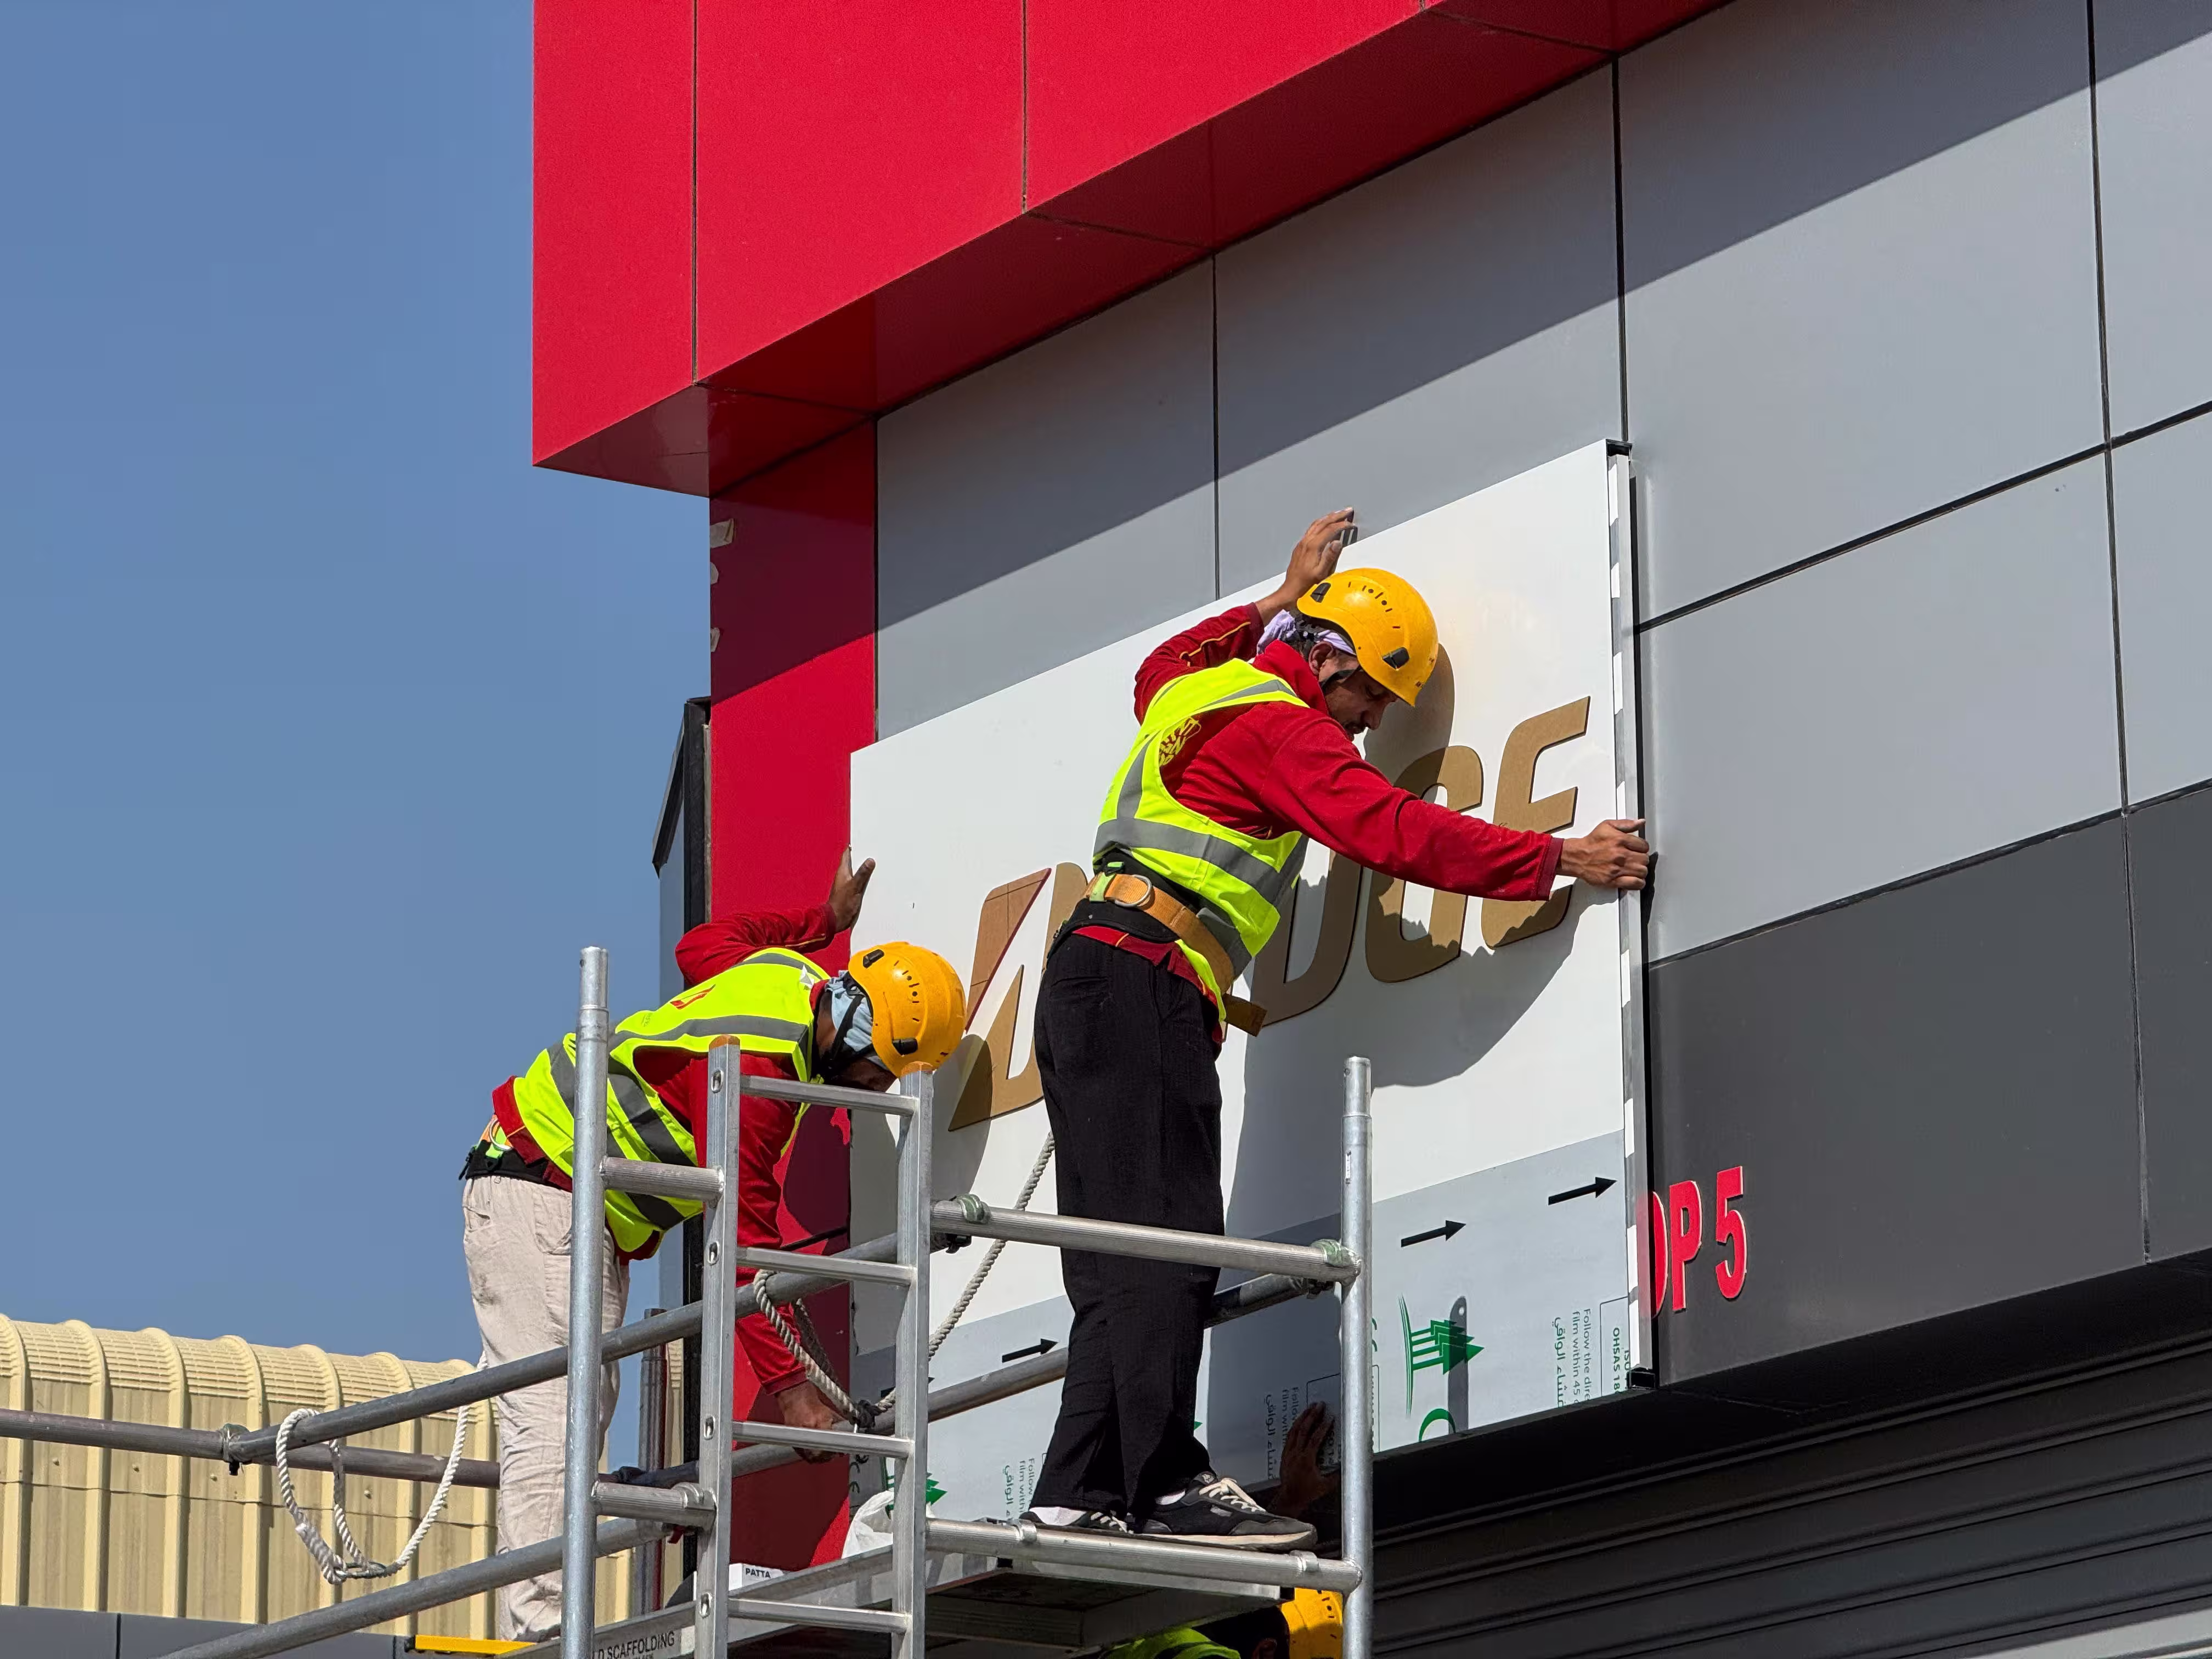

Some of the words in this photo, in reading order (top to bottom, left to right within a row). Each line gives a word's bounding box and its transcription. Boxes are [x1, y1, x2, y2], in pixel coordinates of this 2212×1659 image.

[1716, 1166, 1747, 1300] 5
[1551, 1317, 1566, 1360] الواقي
[1572, 1380, 1580, 1395] 45
[746, 1568, 771, 1578] PATTA
[607, 1631, 675, 1659] SCAFFOLDING
